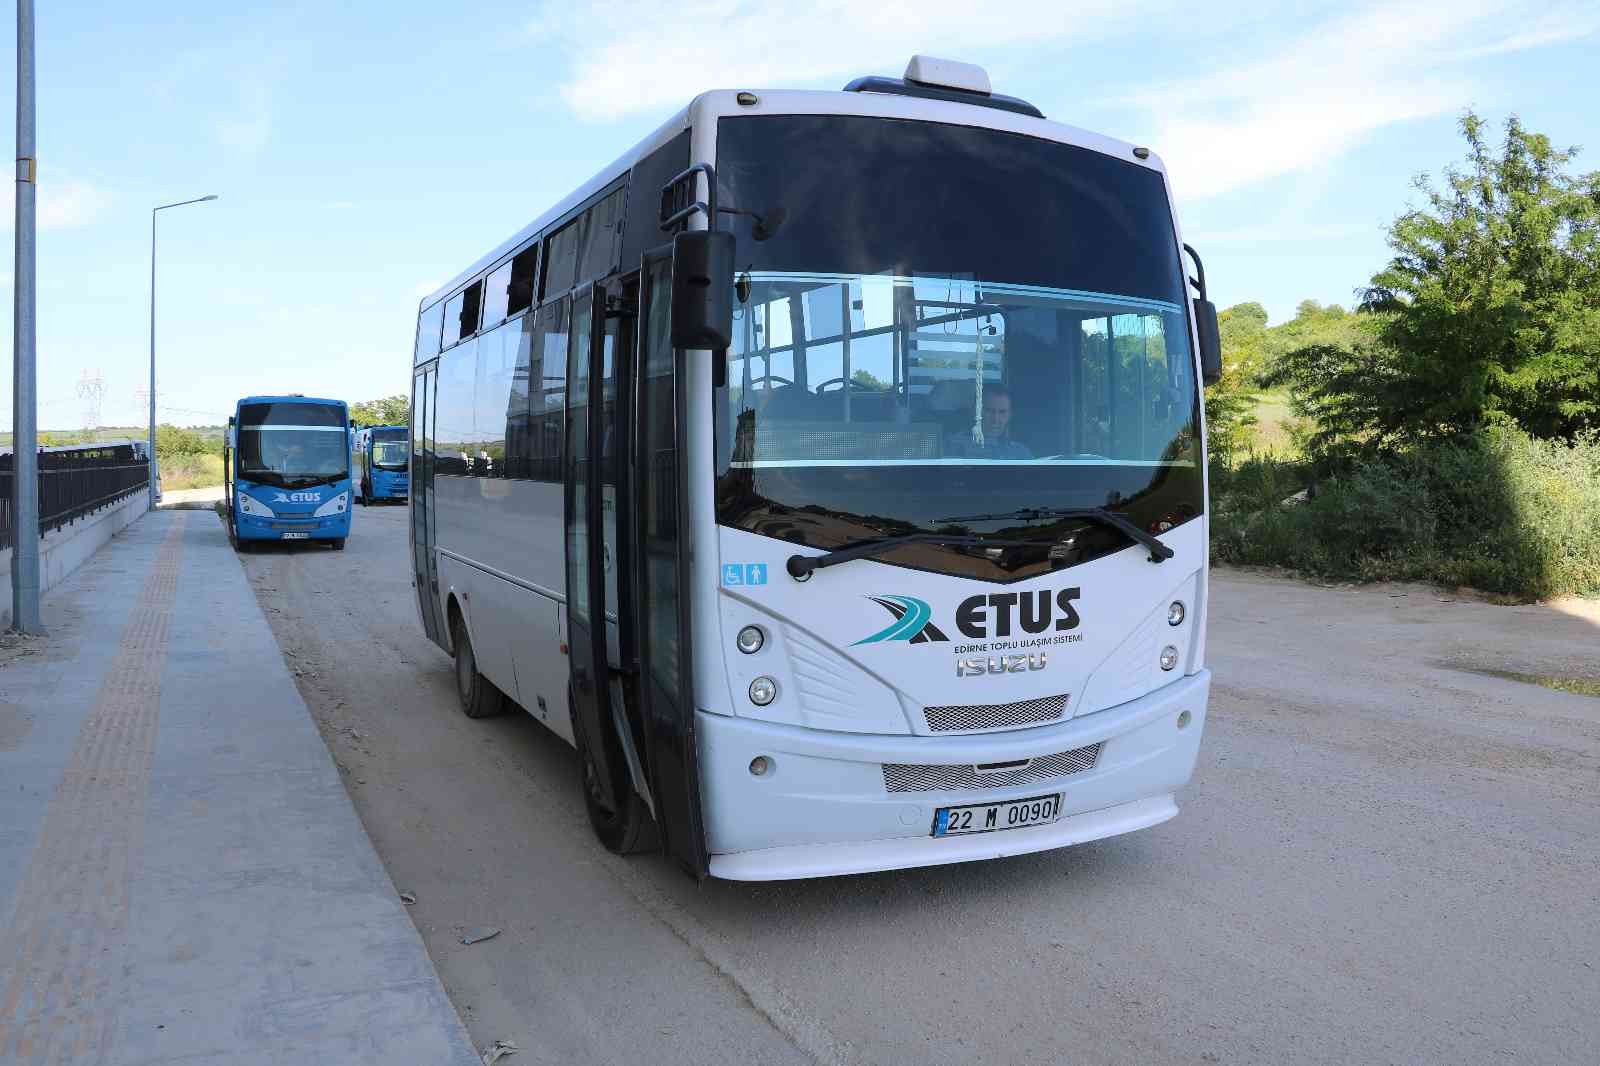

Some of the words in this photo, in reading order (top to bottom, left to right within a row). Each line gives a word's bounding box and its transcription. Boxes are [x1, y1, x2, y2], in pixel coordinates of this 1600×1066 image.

[290, 492, 321, 502] ETUS
[956, 587, 1081, 638] ETUS
[954, 643, 988, 654] EDİRNE
[990, 639, 1018, 651] TOPLU
[1020, 637, 1052, 649] ULAŞIM
[956, 652, 1047, 677] ISUZU
[948, 810, 973, 830] 22
[985, 808, 998, 828] M
[1008, 801, 1052, 825] 0090
